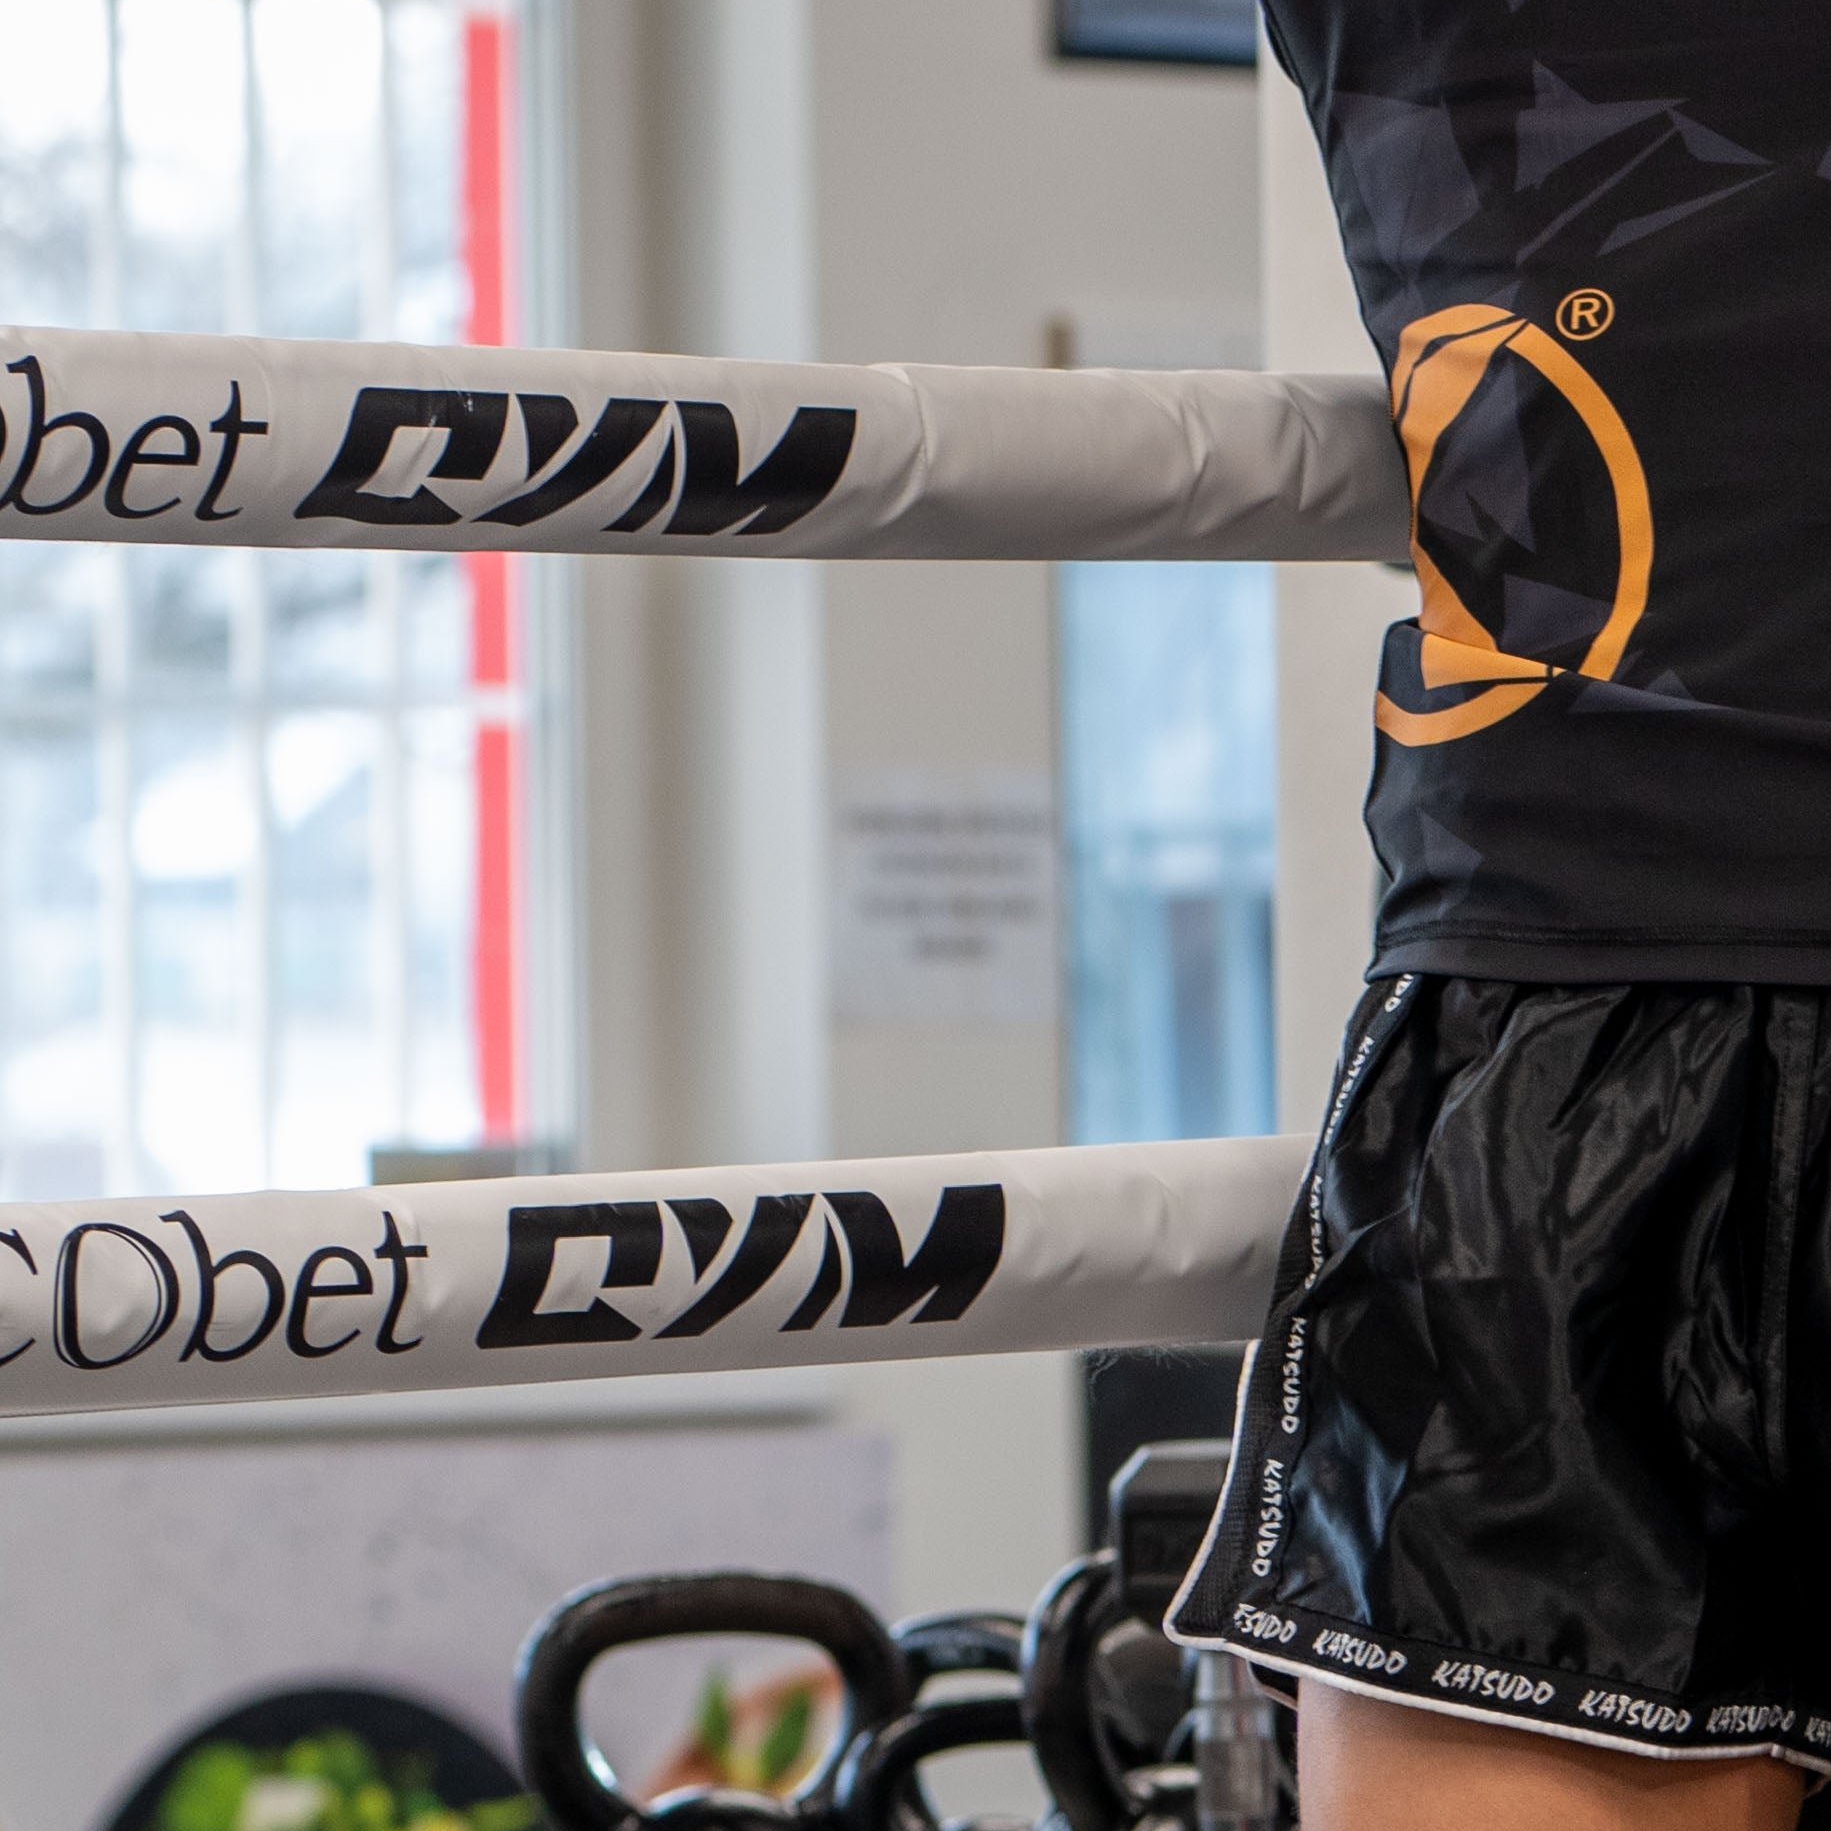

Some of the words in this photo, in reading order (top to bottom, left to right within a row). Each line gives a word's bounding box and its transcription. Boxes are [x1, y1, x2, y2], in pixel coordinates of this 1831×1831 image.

[0, 355, 268, 521] bet
[293, 386, 858, 536] GYM
[475, 1183, 1003, 1349] GYM
[1281, 1317, 1306, 1435] KATSUDO
[1252, 1458, 1285, 1578] KATSUDO
[1312, 1628, 1408, 1676] KATSUDO
[1431, 1659, 1557, 1706] KATSUDO
[1578, 1689, 1693, 1734] KATSUDO
